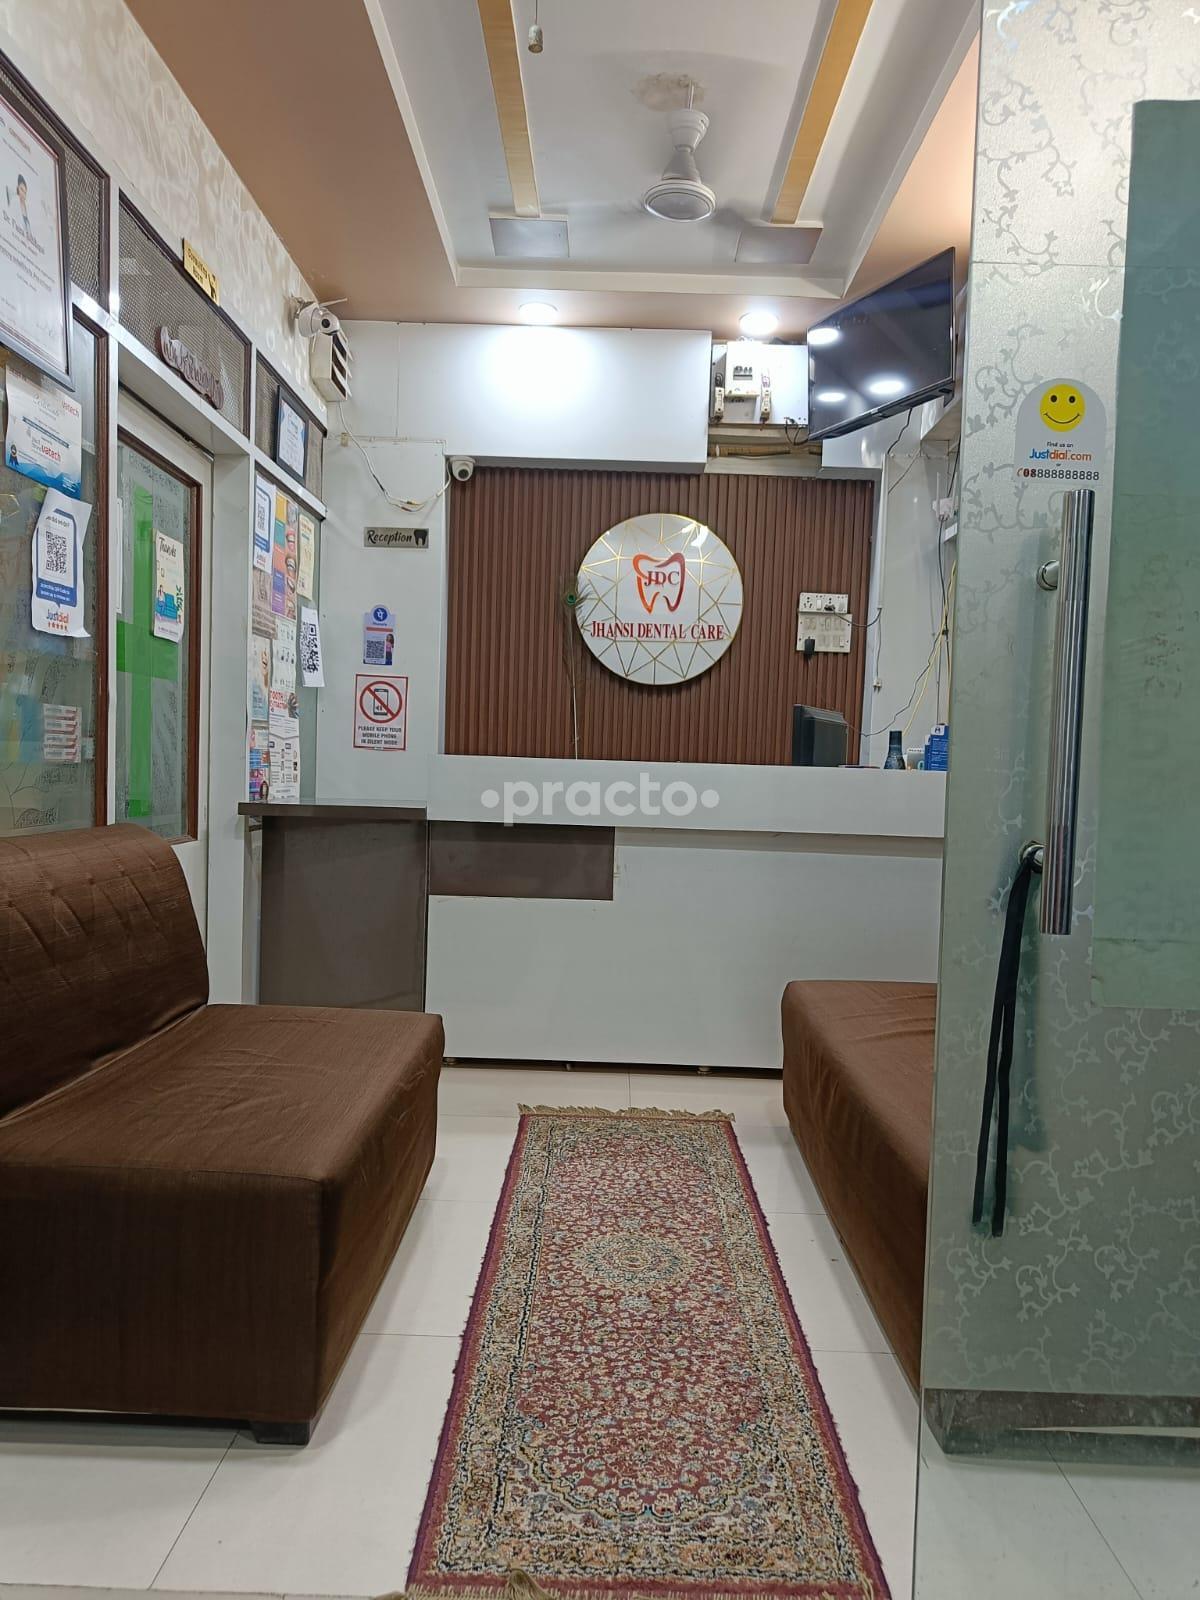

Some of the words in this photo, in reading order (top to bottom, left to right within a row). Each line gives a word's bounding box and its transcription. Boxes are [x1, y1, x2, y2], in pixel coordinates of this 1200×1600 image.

[41, 444, 62, 462] vatech
[1029, 448, 1092, 461] Justdial.com
[1023, 468, 1100, 481] 08888888888
[367, 529, 413, 546] Reception
[644, 570, 680, 587] JDC
[46, 608, 70, 624] Justdial
[590, 620, 634, 638] JHANSI
[637, 622, 687, 639] DENTAL
[690, 623, 725, 640] CARE
